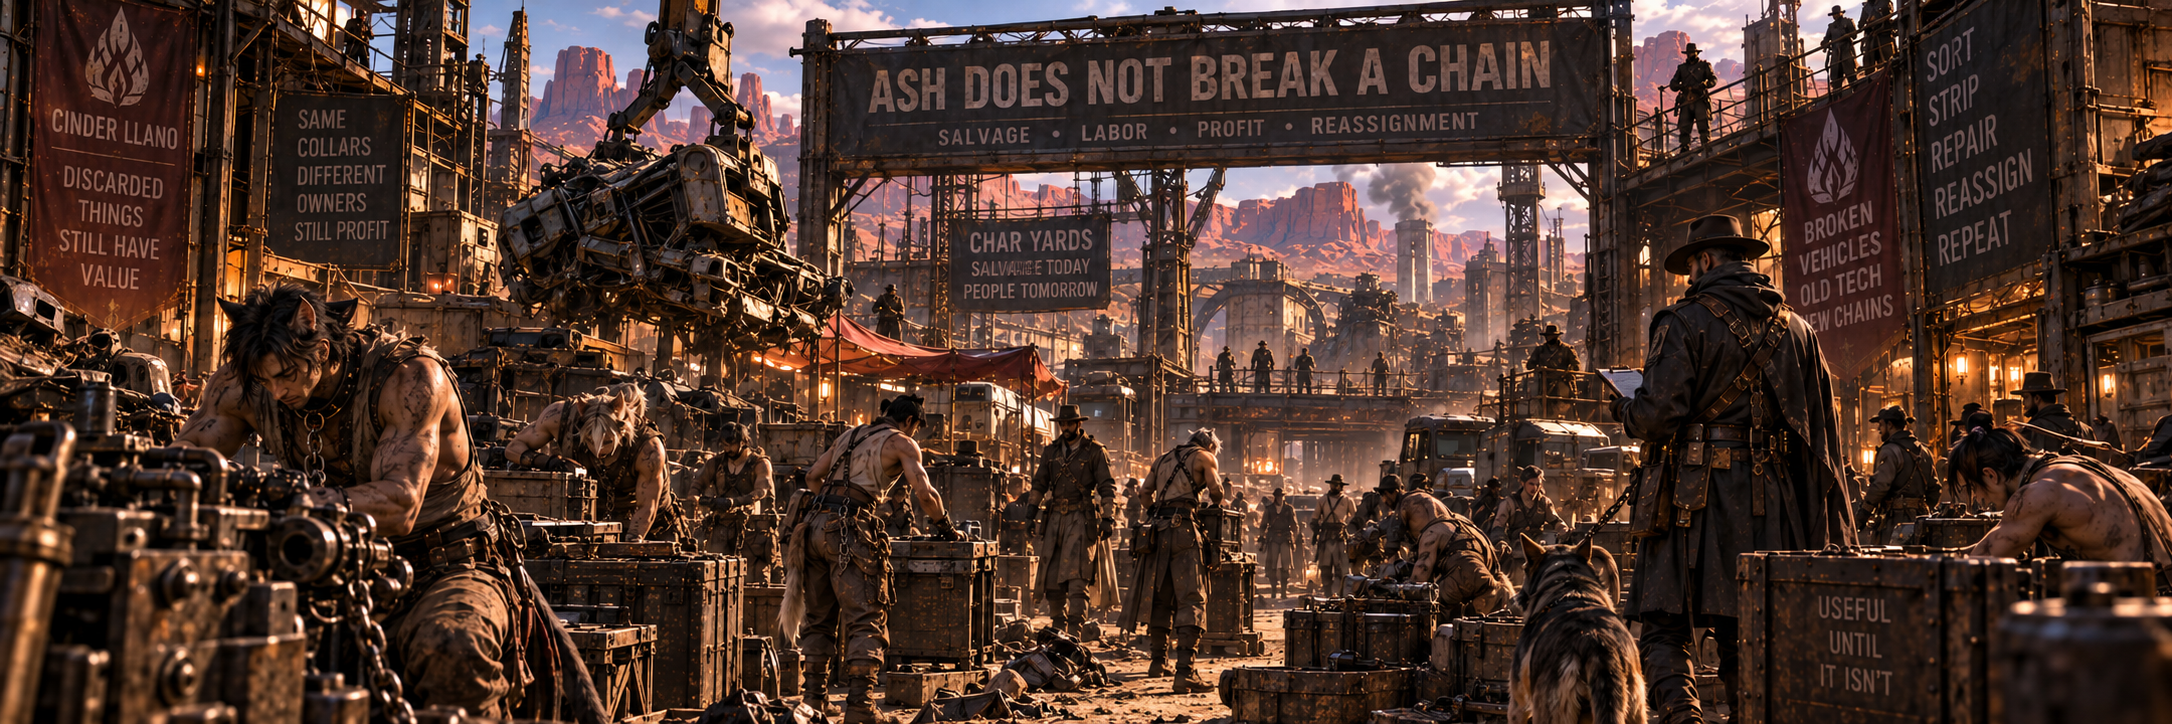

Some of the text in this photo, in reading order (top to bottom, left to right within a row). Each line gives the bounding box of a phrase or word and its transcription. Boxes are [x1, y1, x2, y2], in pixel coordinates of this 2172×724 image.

[1926, 27, 1975, 83] SORT
[868, 40, 1552, 114] ASH DOES NOT BREAK A CHAIN
[1928, 74, 1979, 127] STRIP
[51, 108, 179, 151] CINDER LLANO
[298, 109, 346, 130] SAME
[938, 112, 1479, 146] SALVAGE LABOR PROFIT REASSIGNMENT
[298, 136, 372, 158] COLLARS
[1931, 114, 1998, 174] REPAIR
[63, 165, 164, 200] DISCARDED
[298, 164, 386, 186] DIFFERENT
[1934, 148, 2033, 220] REASSIGN
[78, 199, 143, 228] THINGS
[297, 193, 367, 214] OWNERS
[295, 220, 390, 242] STILL PROFIT
[1804, 201, 1874, 245] BROKEN
[1937, 210, 2012, 267] REPEAT
[59, 229, 160, 260] STILL HAVE
[970, 228, 1093, 253] CHAR YARDS
[1799, 231, 1882, 276] VEHICLES
[81, 263, 140, 290] VALUE
[1045, 258, 1091, 275] TODAY
[964, 281, 1098, 299] PEOPLE TOMORROW
[1800, 263, 1882, 307] OLD TECH
[1834, 294, 1894, 328] CHAINS
[1818, 595, 1892, 624] USEFUL
[1829, 630, 1883, 659] UNTIL
[1820, 663, 1893, 697] IT ISN'T
